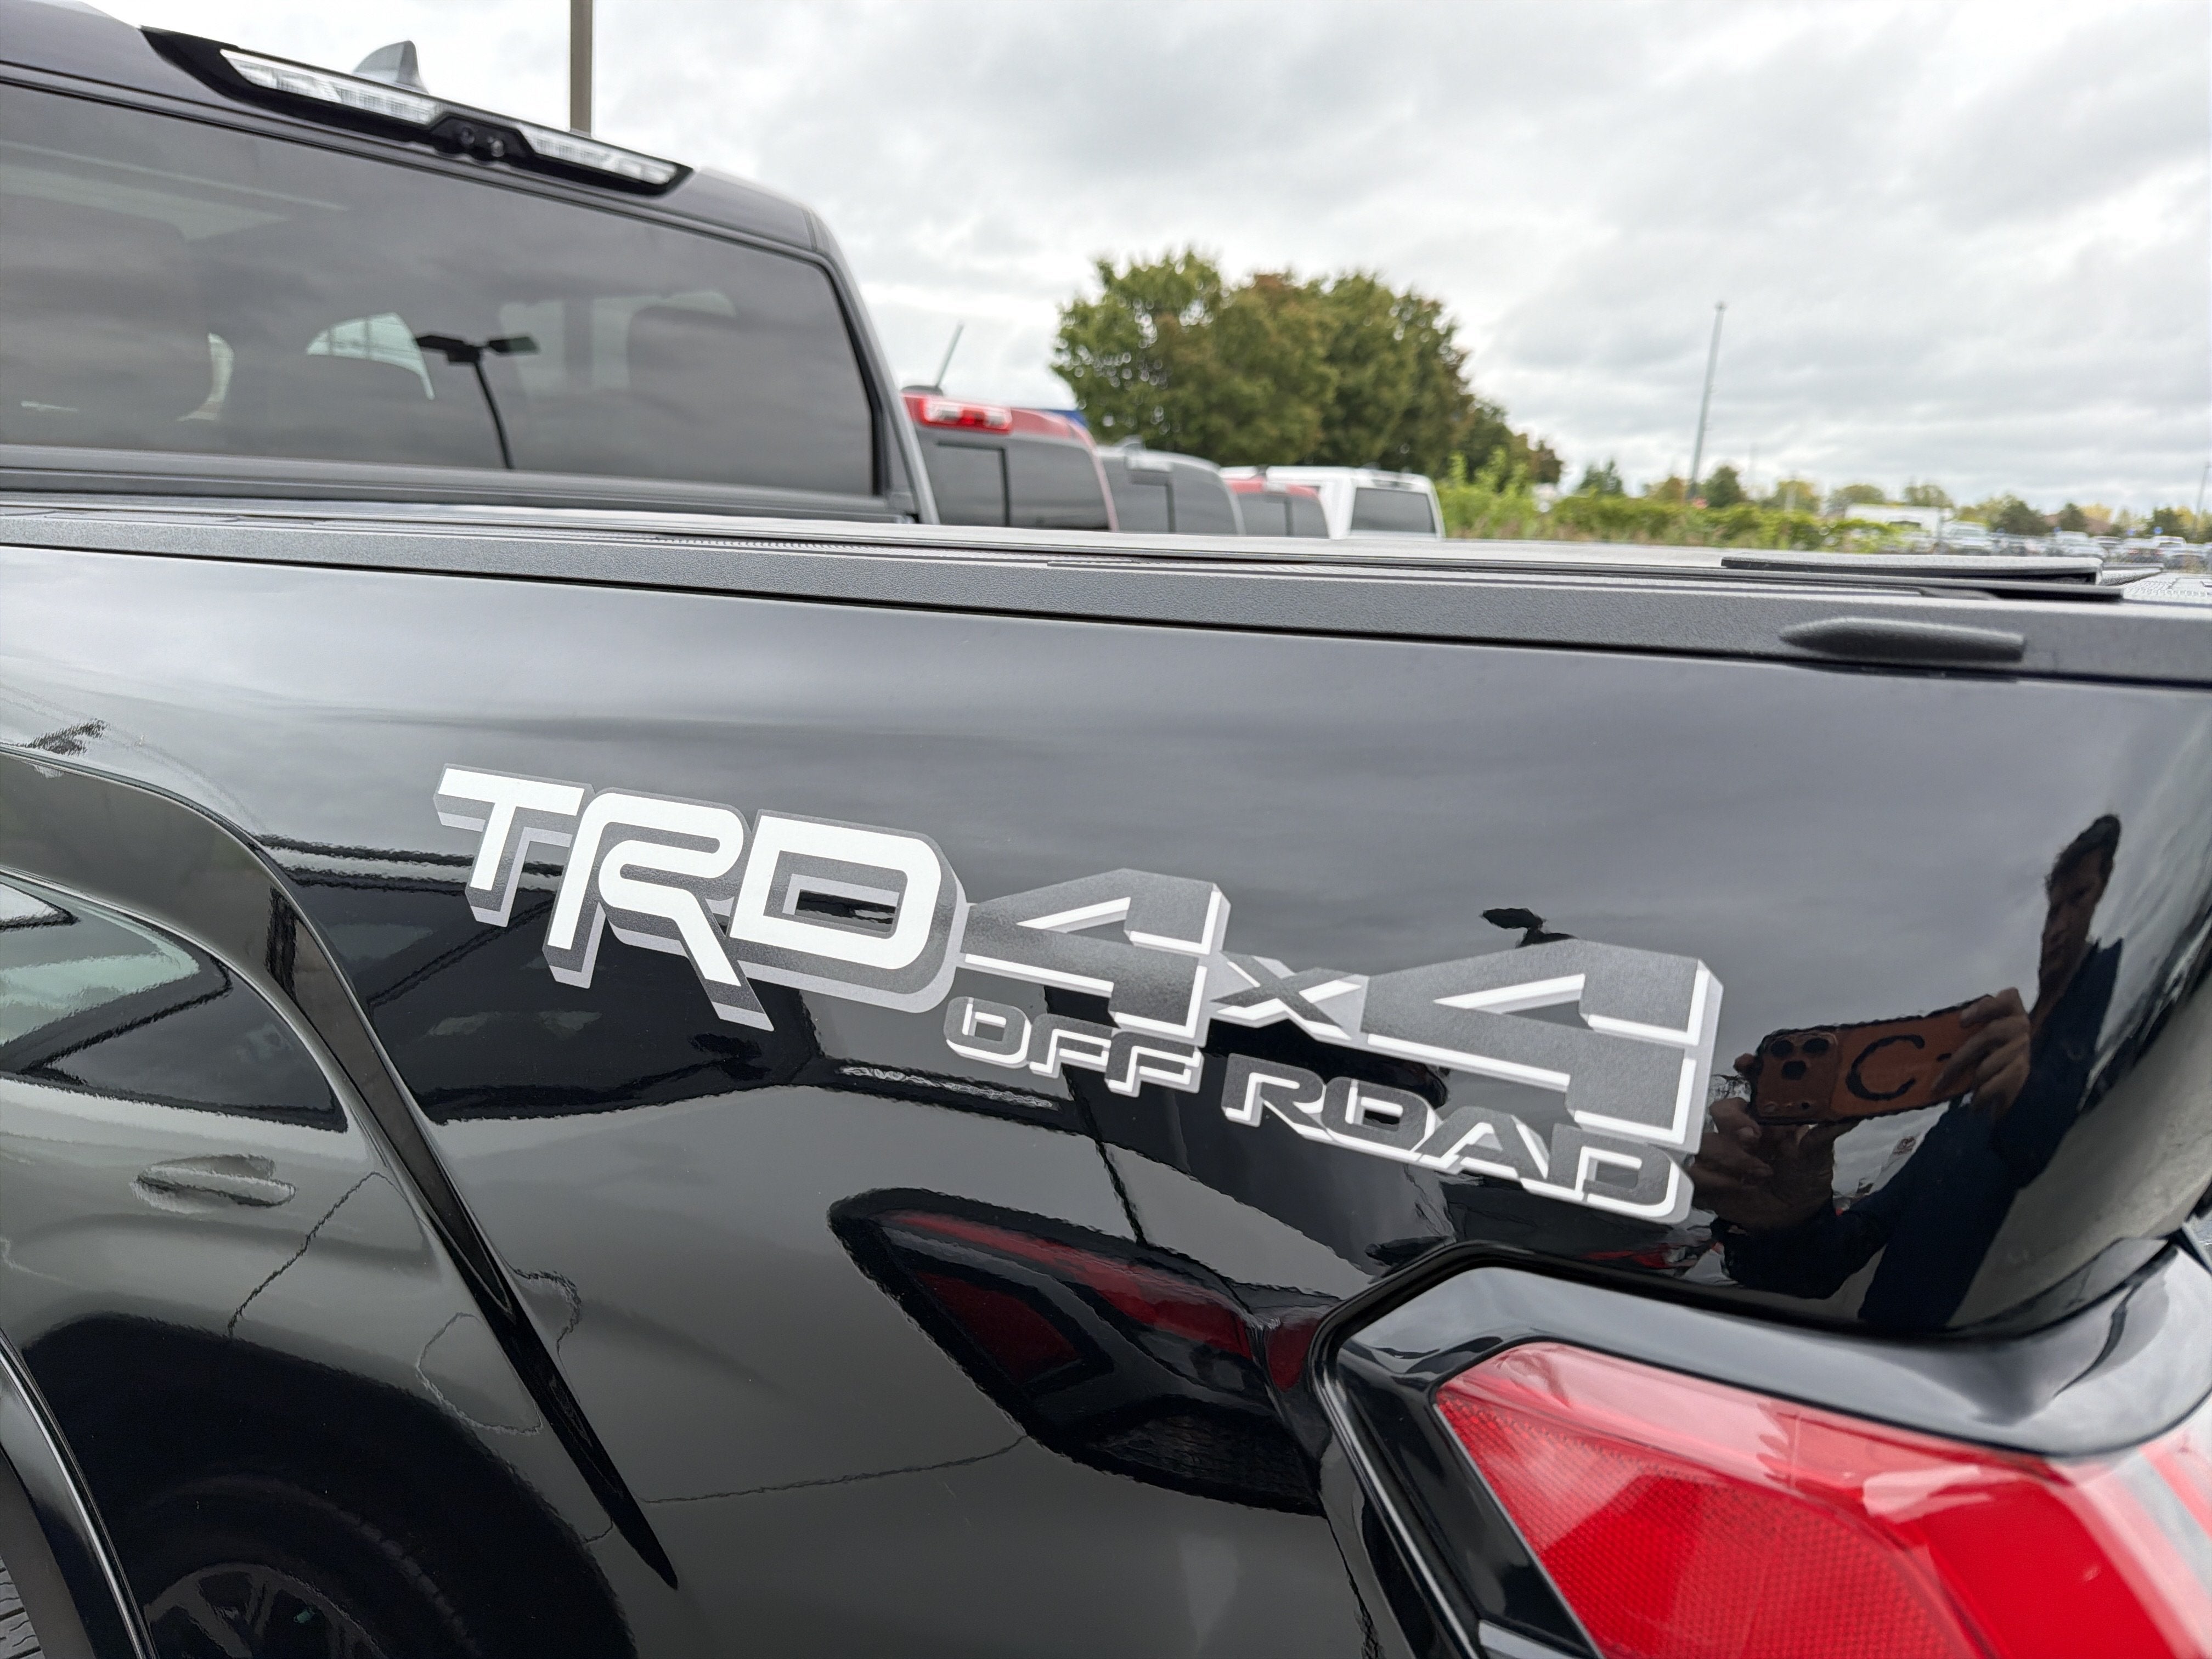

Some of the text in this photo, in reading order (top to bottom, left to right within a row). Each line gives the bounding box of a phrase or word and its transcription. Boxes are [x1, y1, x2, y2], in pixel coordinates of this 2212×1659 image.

[433, 764, 964, 1031] TRD
[944, 996, 1694, 1224] OFF ROAD
